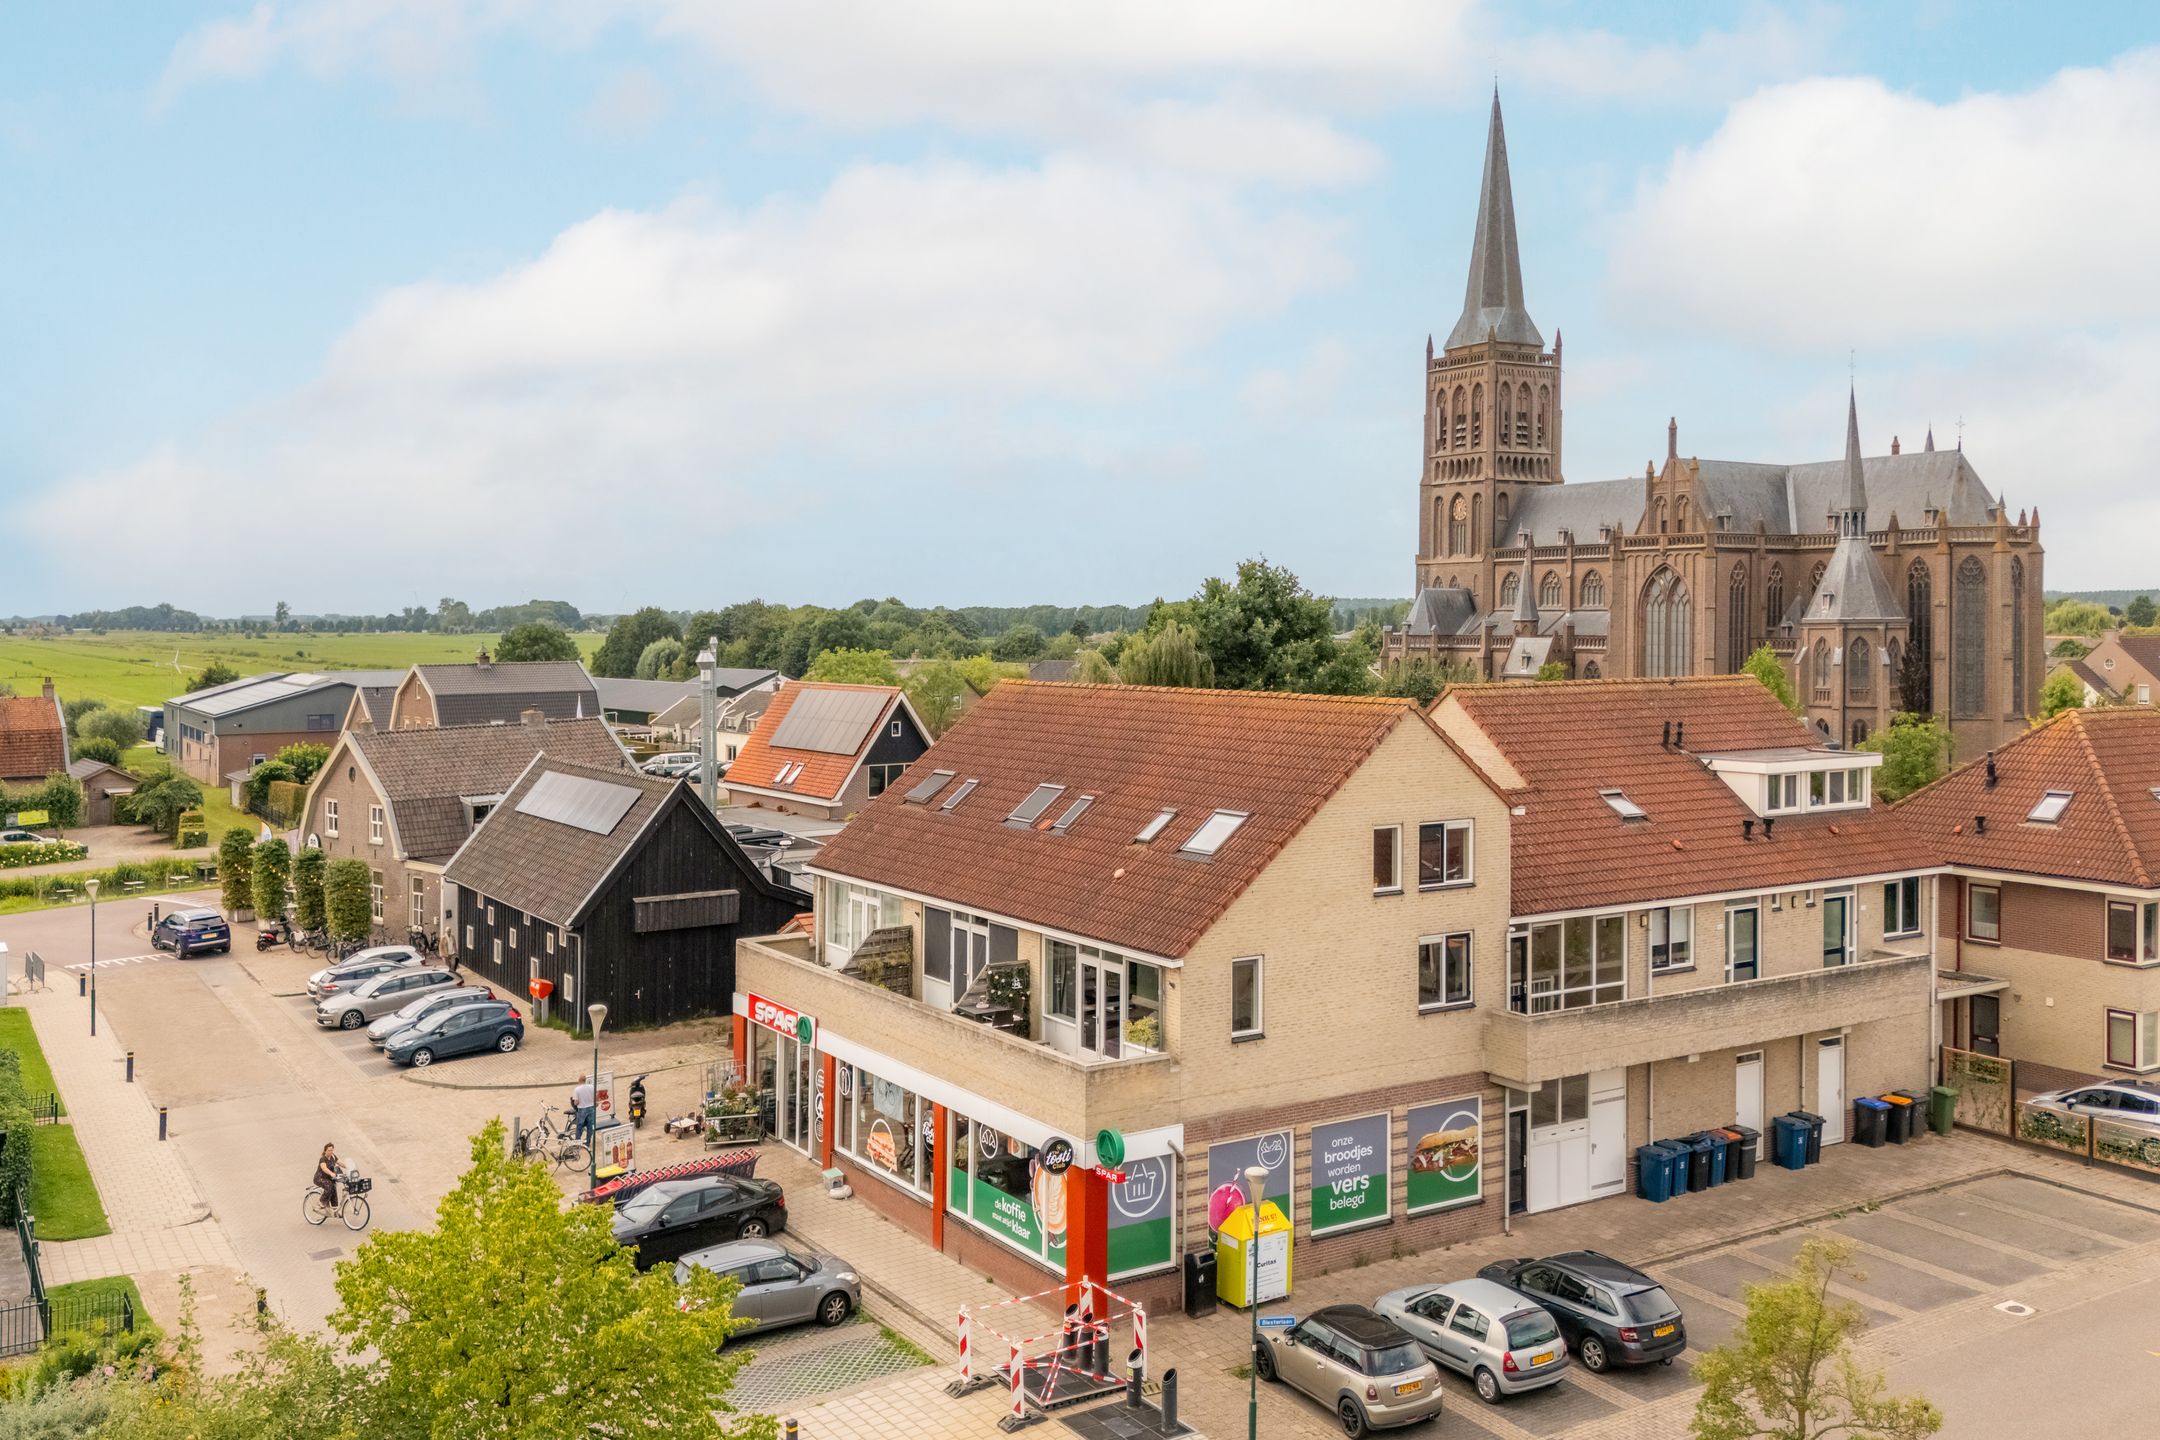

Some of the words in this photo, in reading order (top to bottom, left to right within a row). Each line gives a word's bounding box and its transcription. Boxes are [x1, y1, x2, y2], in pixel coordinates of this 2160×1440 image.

[755, 1002, 797, 1035] SPAR
[1332, 1136, 1353, 1148] onze
[1046, 1148, 1072, 1166] tosti
[1324, 1145, 1373, 1164] broodjes
[1096, 1167, 1117, 1182] SPAR
[1328, 1163, 1361, 1177] worden
[1331, 1174, 1370, 1195] vers
[994, 1199, 1002, 1210] de
[1002, 1196, 1026, 1222] koffie
[1330, 1191, 1365, 1211] belegd
[1011, 1219, 1031, 1240] klaar
[1256, 1259, 1277, 1268] Curitas
